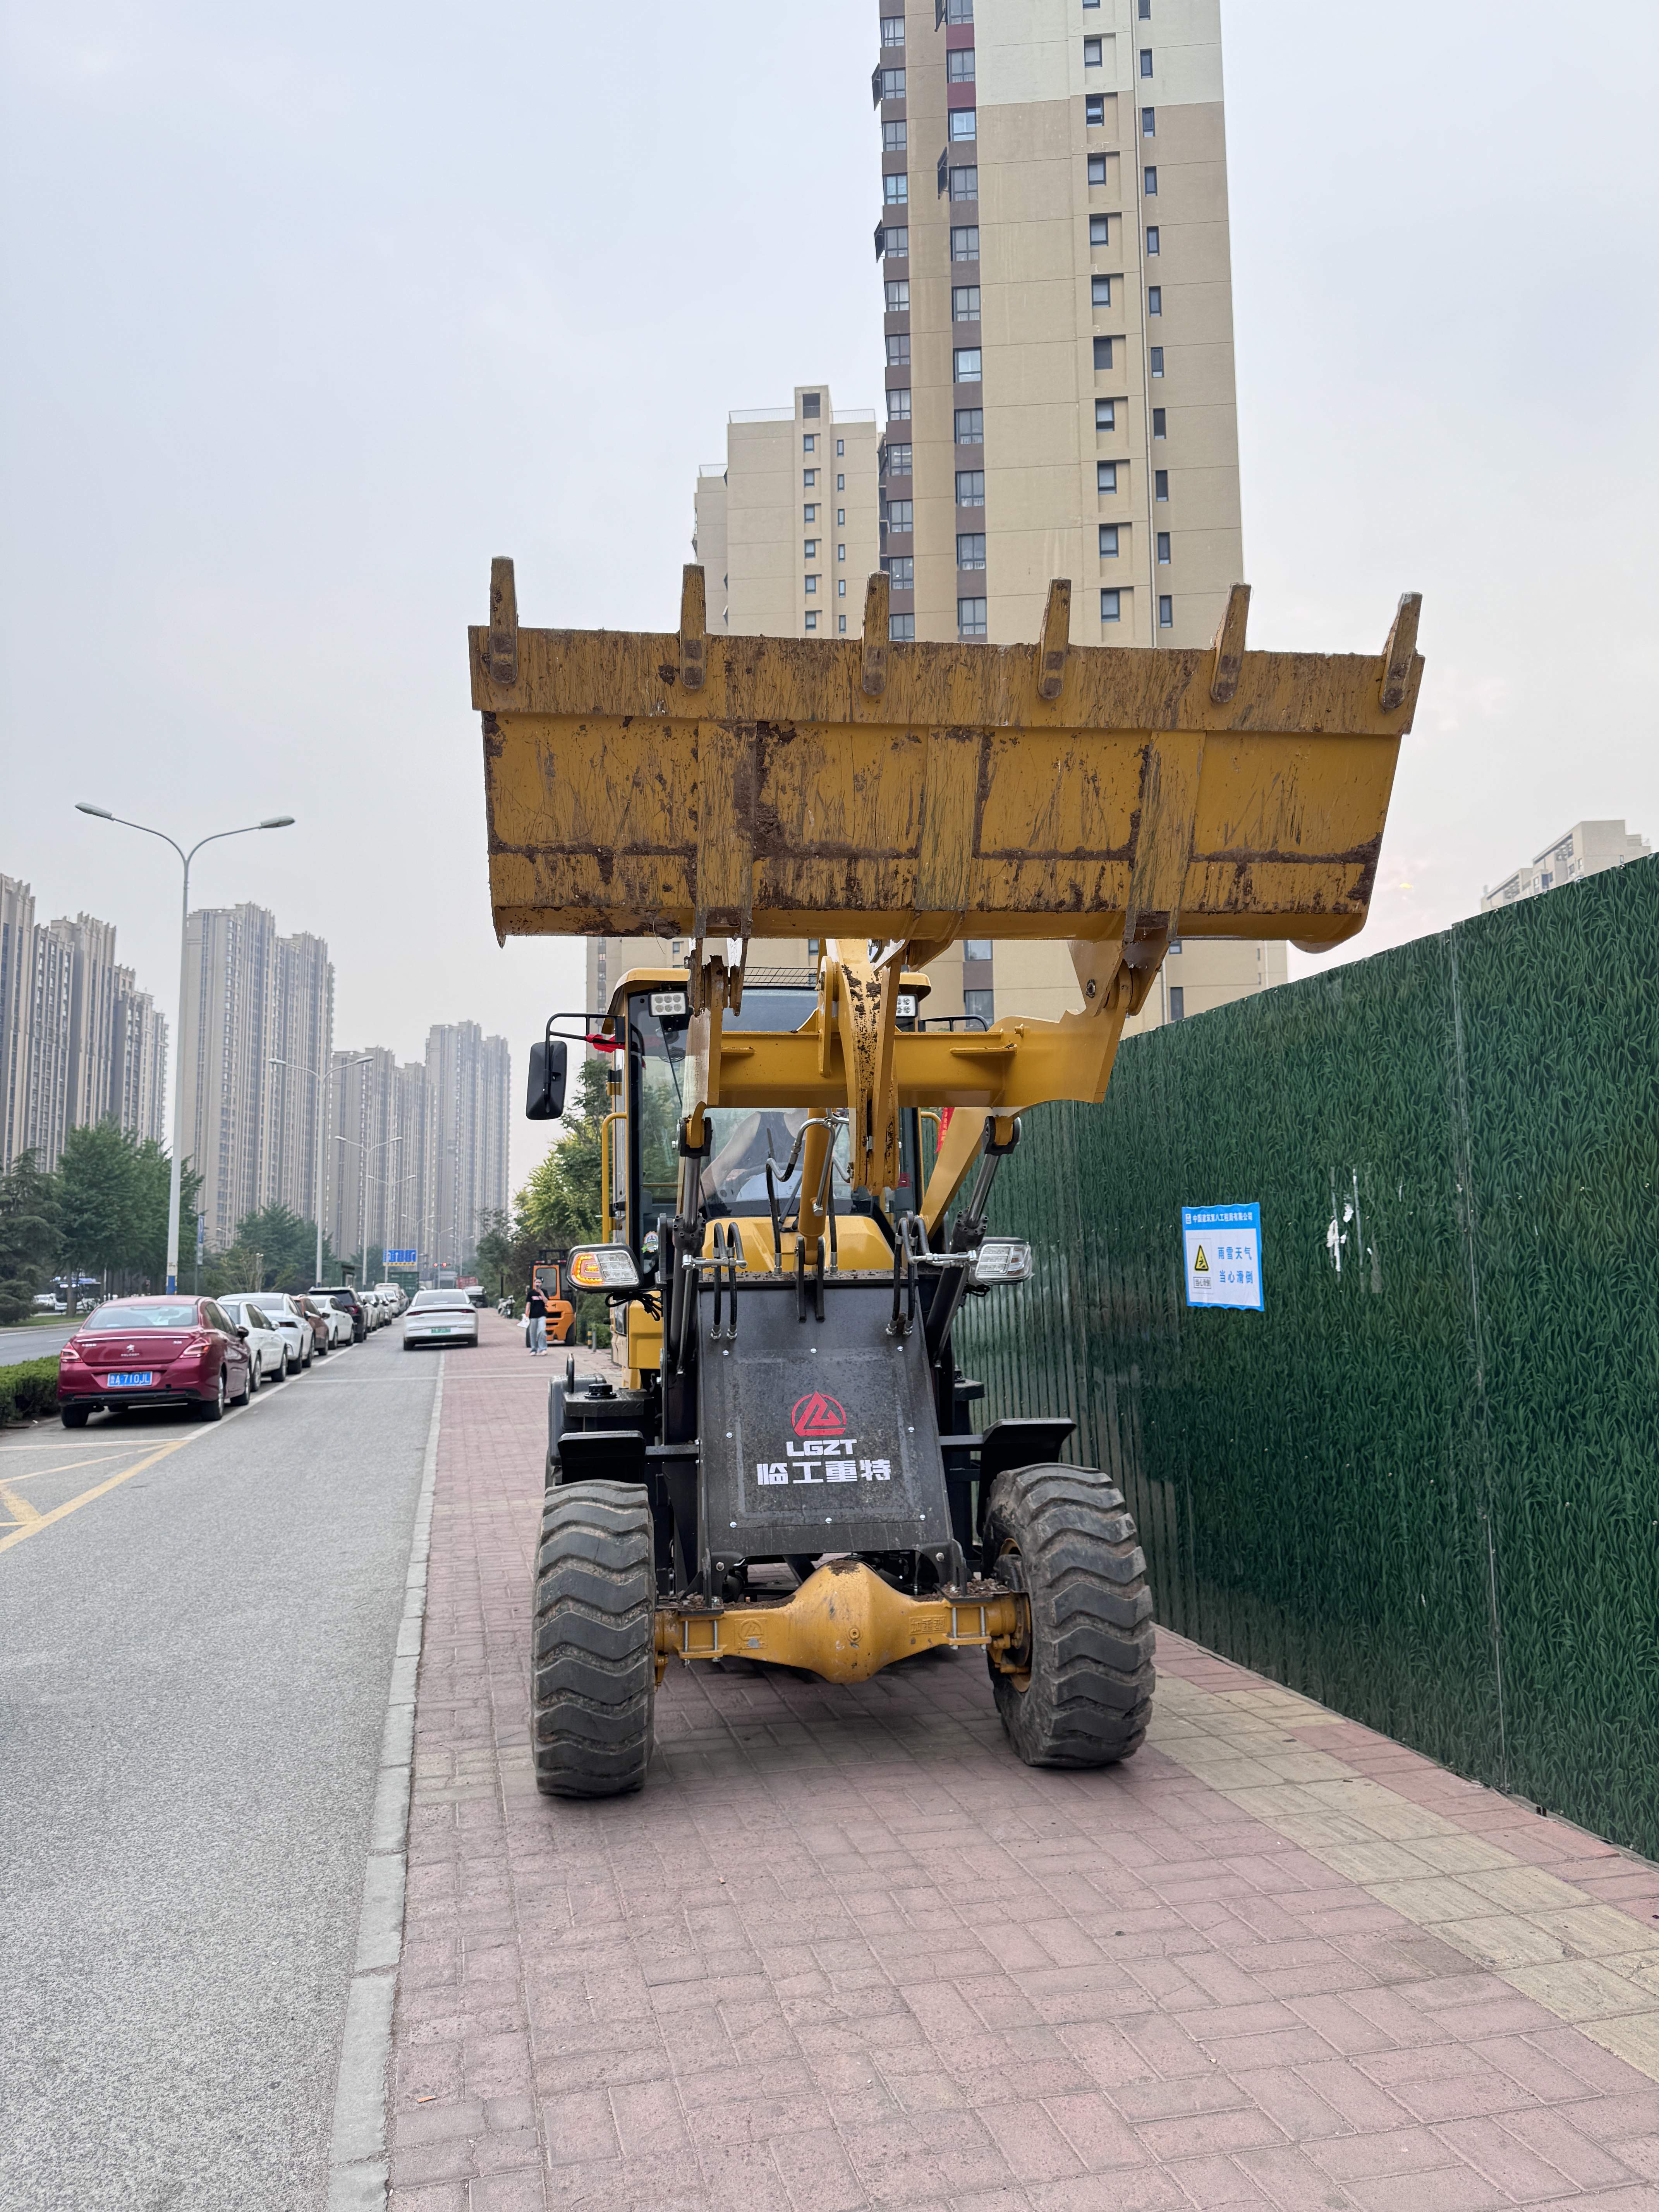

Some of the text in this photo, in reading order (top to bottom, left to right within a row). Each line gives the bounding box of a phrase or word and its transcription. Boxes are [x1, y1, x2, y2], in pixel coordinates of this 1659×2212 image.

[1218, 1246, 1252, 1260] 雨雪天气
[1219, 1270, 1253, 1283] 当心滑倒
[786, 1439, 857, 1456] LGZT
[757, 1459, 891, 1485] 临工重特
